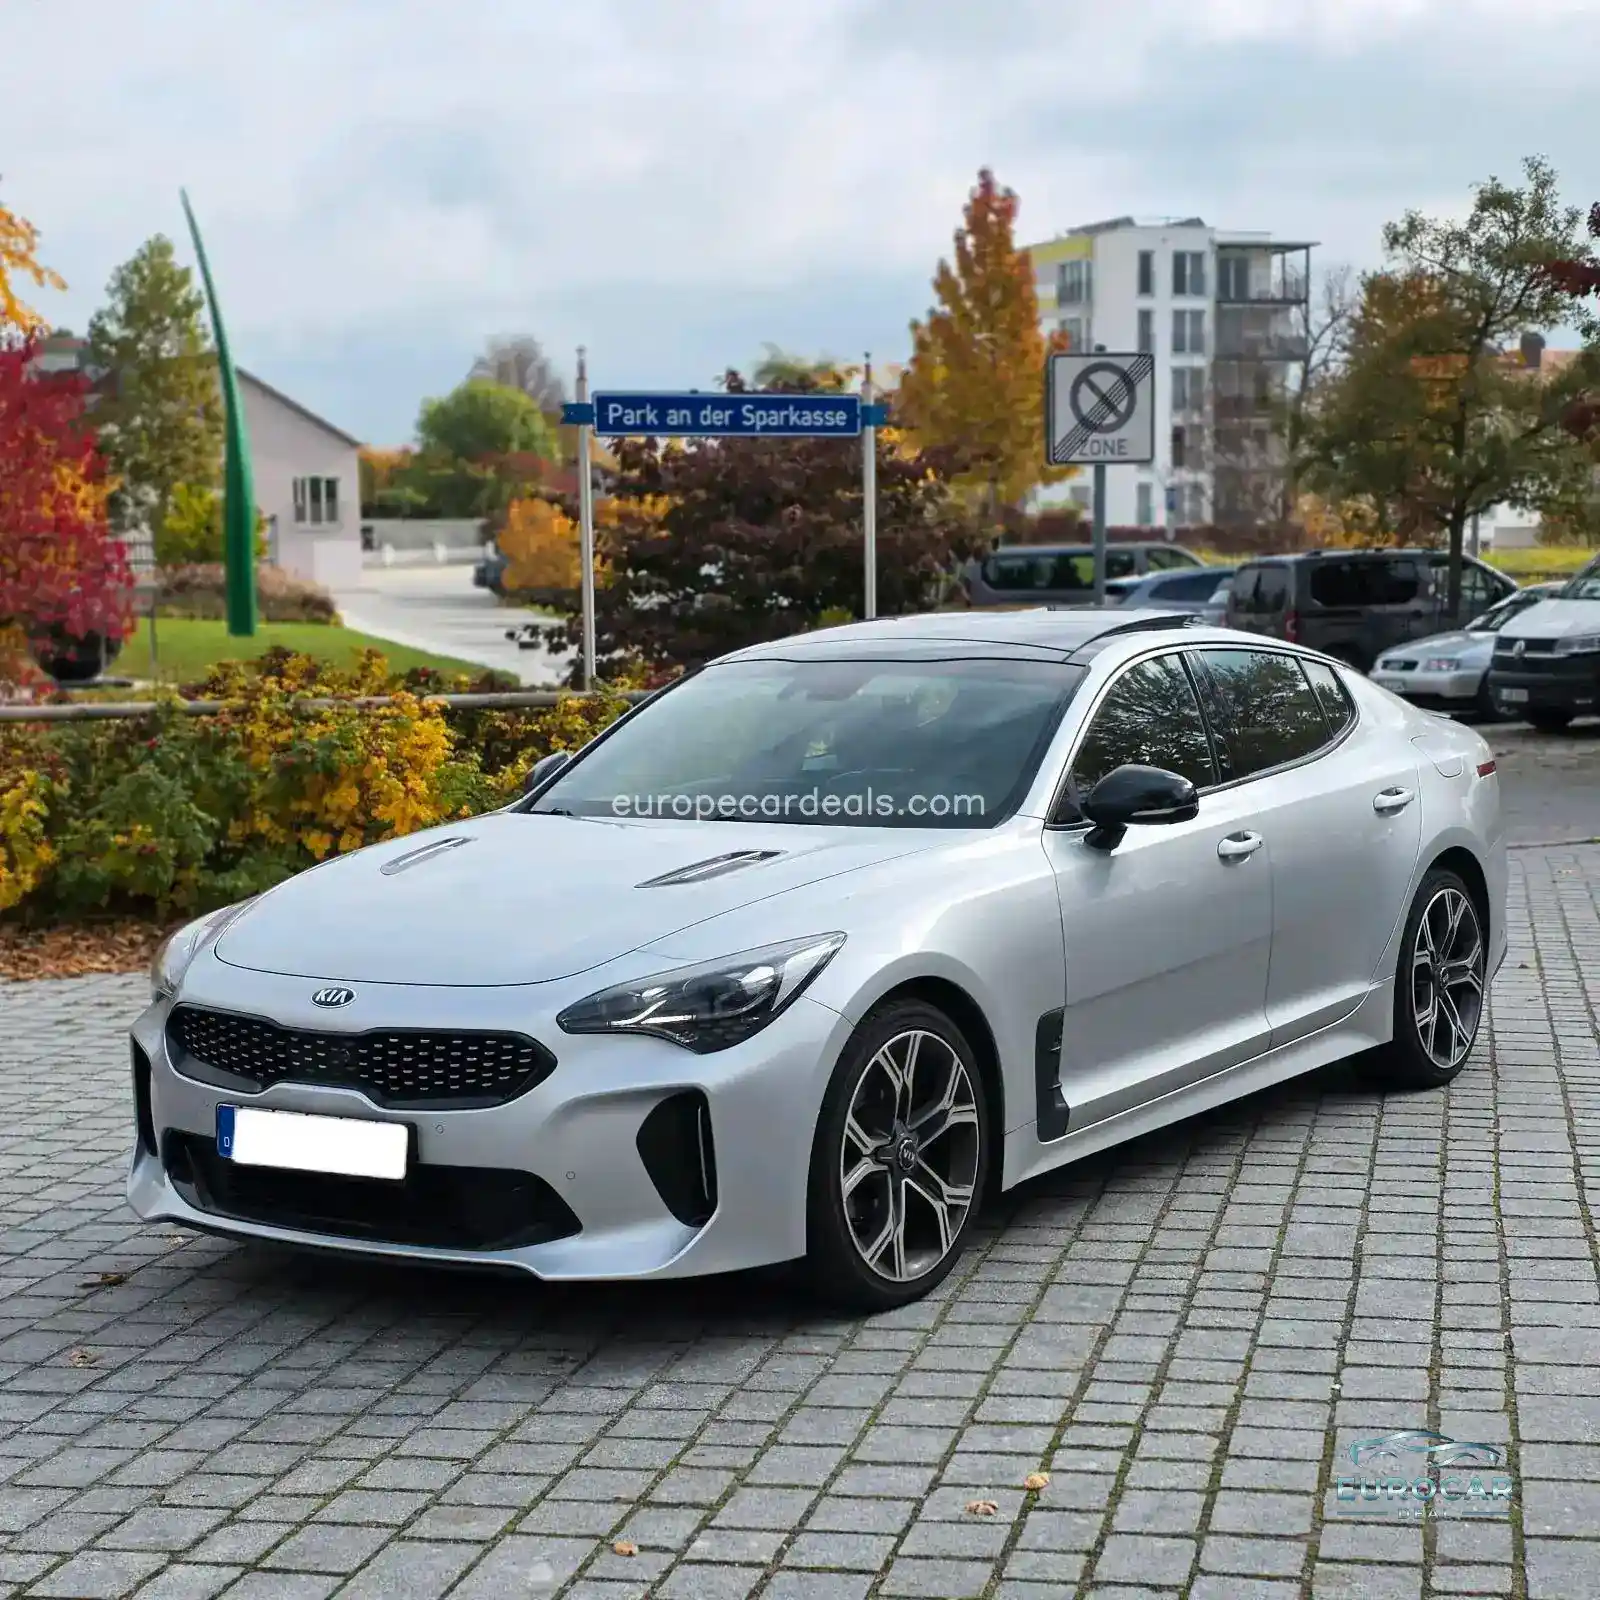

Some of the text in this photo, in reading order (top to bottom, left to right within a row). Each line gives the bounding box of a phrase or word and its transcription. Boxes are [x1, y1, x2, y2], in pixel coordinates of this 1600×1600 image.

[608, 403, 848, 431] Park an der Sparkasse
[1078, 438, 1128, 456] ZONE
[315, 990, 347, 1004] KIA
